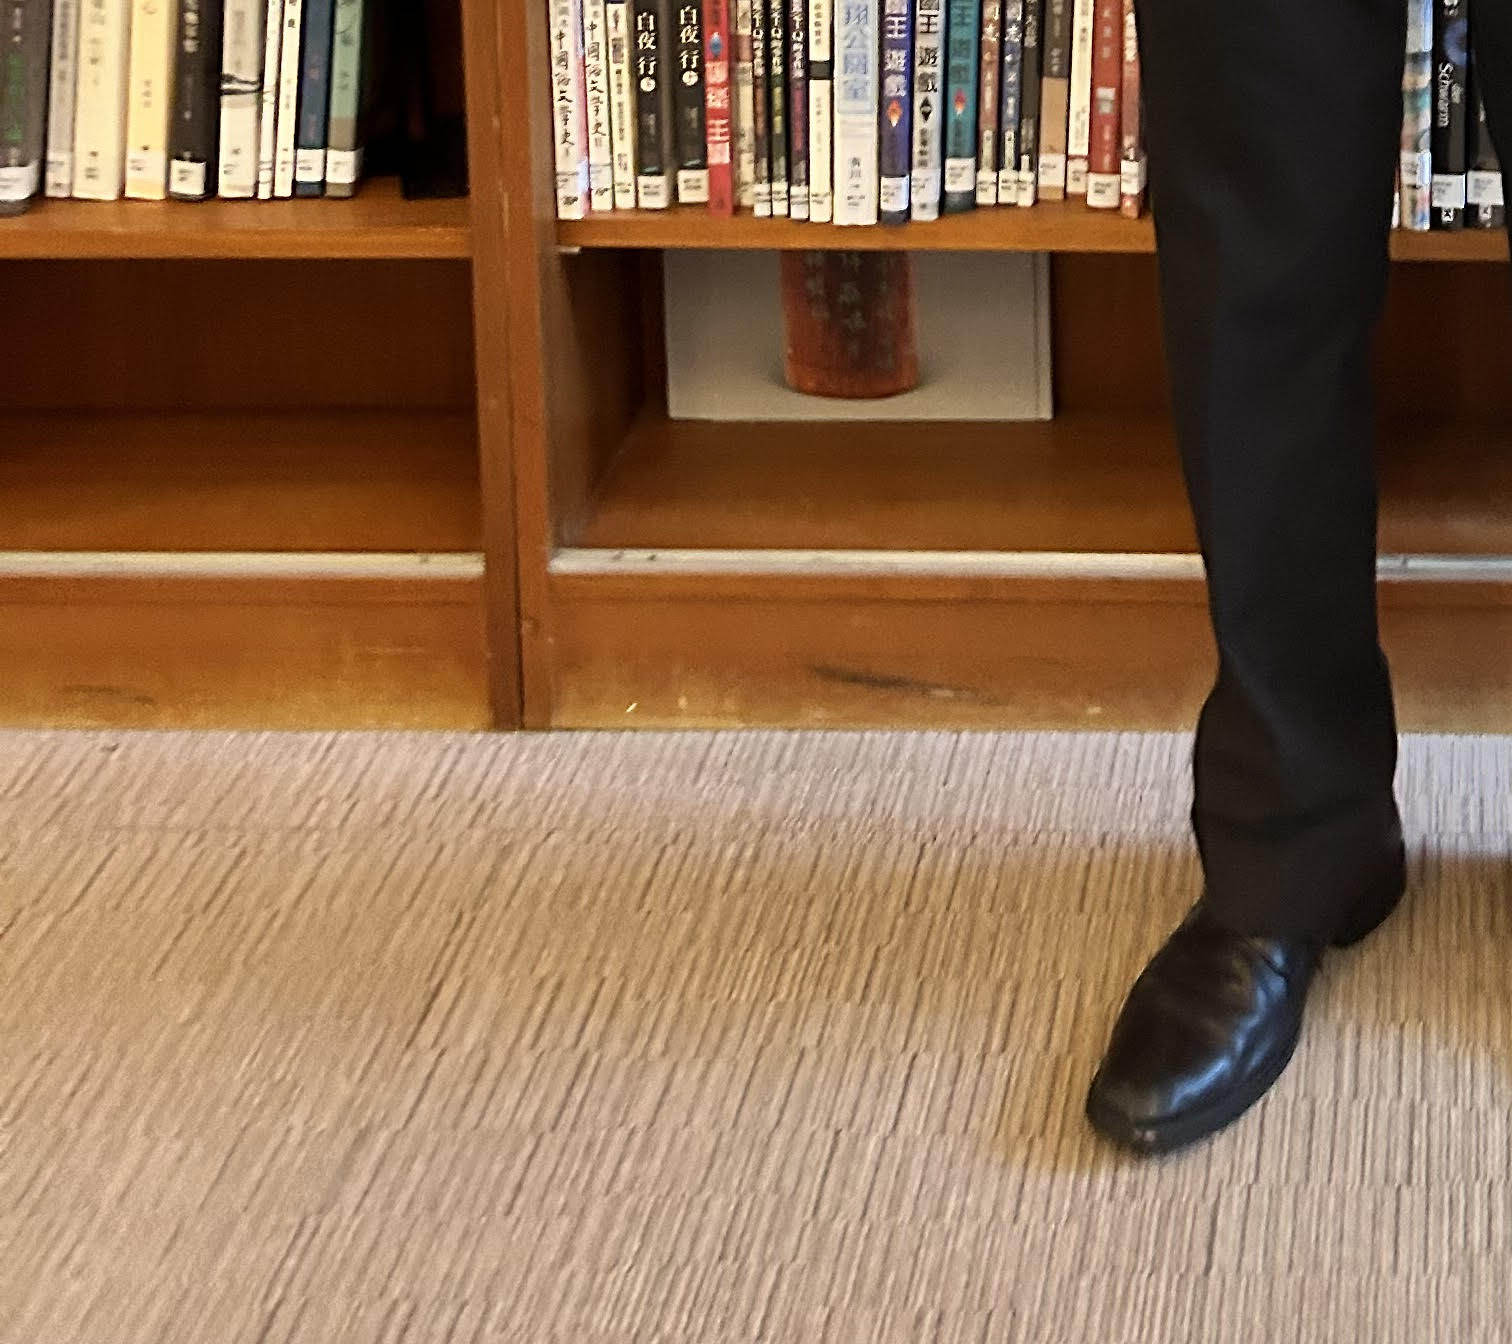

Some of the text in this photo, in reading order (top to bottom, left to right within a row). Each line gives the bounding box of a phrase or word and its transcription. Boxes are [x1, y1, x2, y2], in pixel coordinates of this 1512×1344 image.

[637, 12, 656, 75] 白夜行
[679, 5, 699, 69] 白夜行
